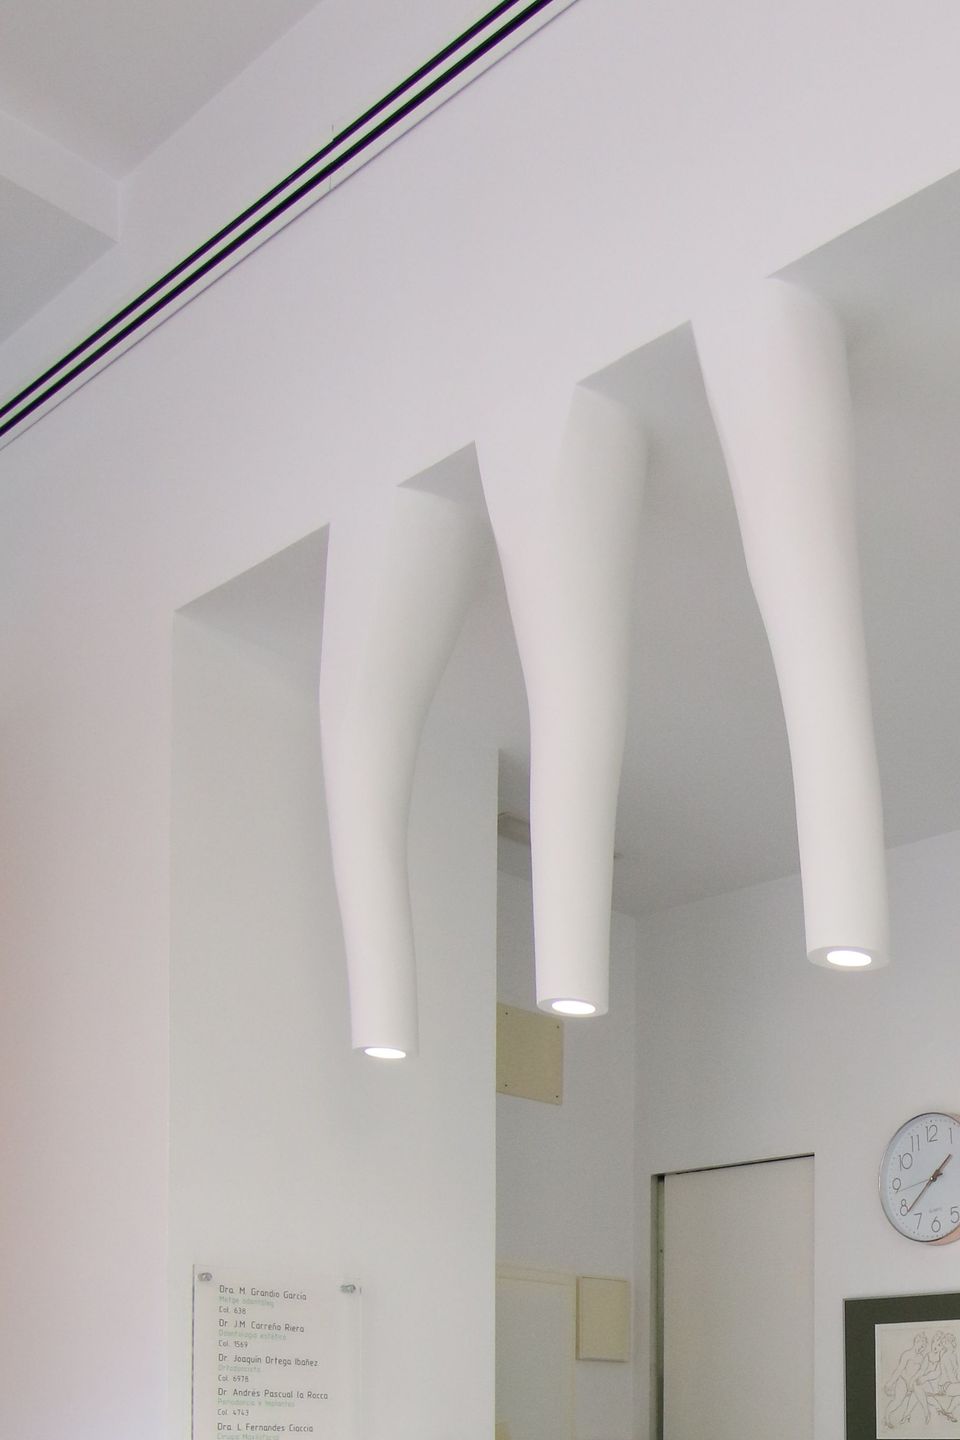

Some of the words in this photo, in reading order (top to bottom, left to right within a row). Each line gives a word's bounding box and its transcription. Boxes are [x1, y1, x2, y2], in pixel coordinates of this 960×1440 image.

[925, 1124, 938, 1142] 12
[910, 1134, 920, 1152] 11
[898, 1152, 913, 1171] 10
[892, 1177, 901, 1194] 9
[899, 1198, 908, 1216] 8
[950, 1206, 960, 1224] 5
[913, 1212, 923, 1230] 7
[931, 1216, 941, 1233] 6
[233, 1306, 247, 1316] 638
[284, 1323, 305, 1333] Riera
[265, 1355, 292, 1368] Ortega
[264, 1388, 294, 1399] Pascual
[307, 1391, 329, 1400] Rocca
